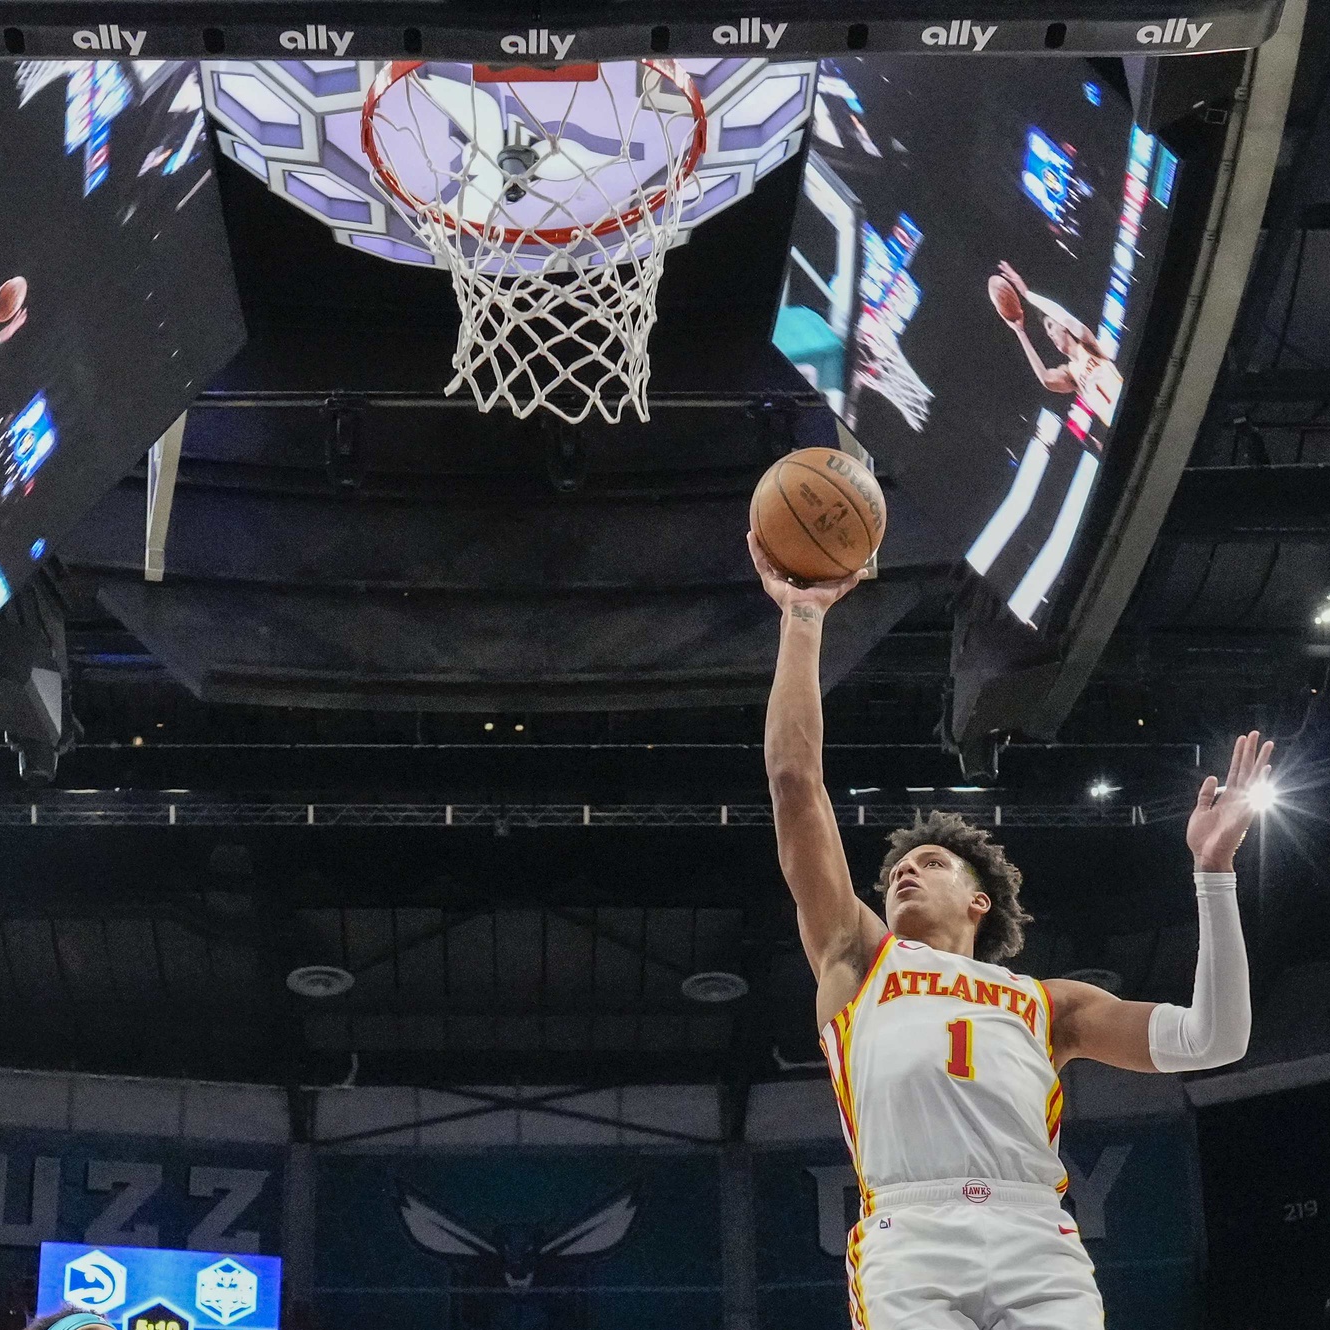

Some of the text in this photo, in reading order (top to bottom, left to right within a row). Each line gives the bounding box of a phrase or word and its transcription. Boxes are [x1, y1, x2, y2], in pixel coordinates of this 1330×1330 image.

[72, 24, 146, 56] ally
[279, 24, 354, 56] ally
[500, 29, 575, 60] ally
[712, 18, 787, 49] ally
[921, 20, 997, 51] ally
[1136, 18, 1212, 48] ally
[877, 970, 1038, 1037] ATLANTA
[946, 1018, 975, 1081] 1
[962, 1185, 991, 1196] HAWKS
